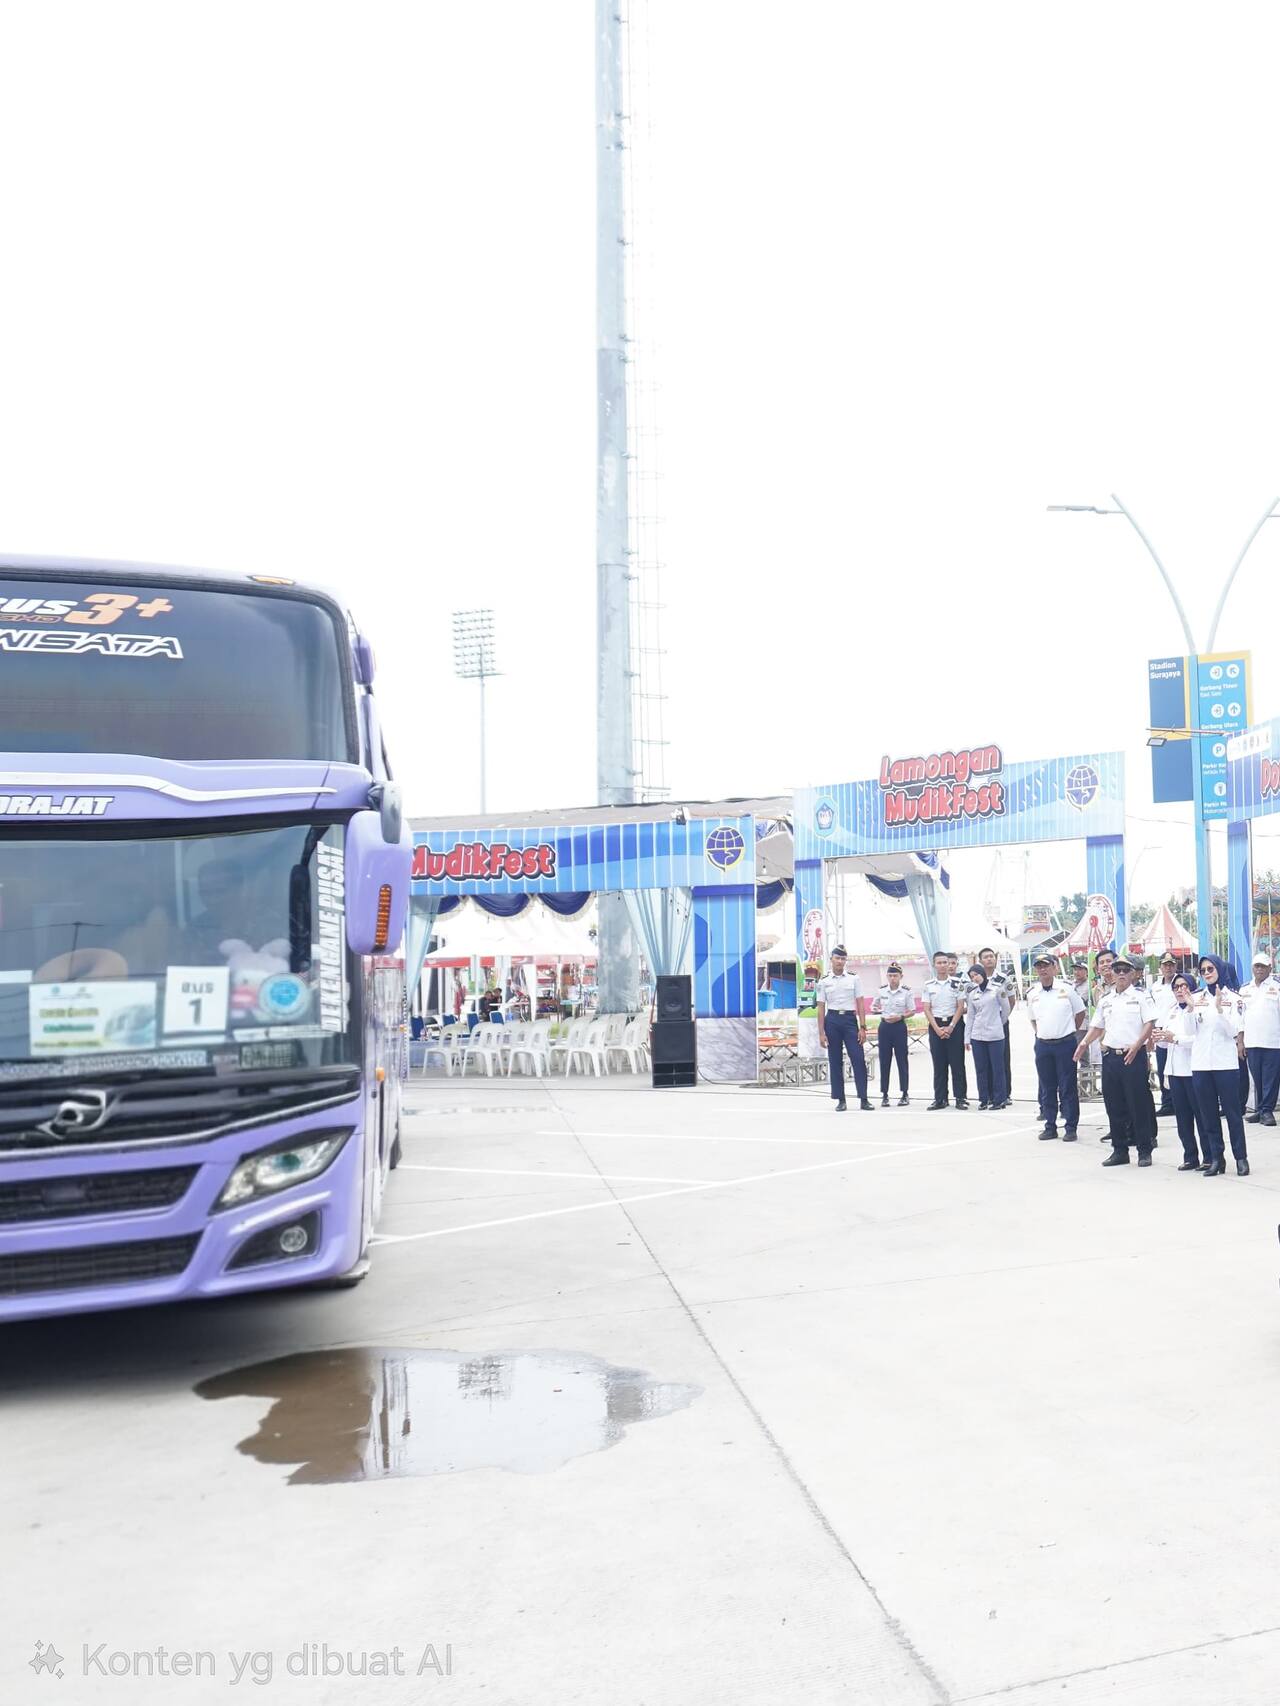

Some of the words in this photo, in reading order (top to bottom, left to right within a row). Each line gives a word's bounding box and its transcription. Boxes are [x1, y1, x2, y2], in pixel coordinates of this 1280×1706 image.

[1149, 661, 1177, 671] Stadion
[1149, 670, 1182, 680] Surajaya
[879, 745, 1003, 788] Lamongan
[885, 781, 1005, 826] MudikFest
[316, 841, 345, 912] PUSAT
[188, 998, 203, 1026] 1
